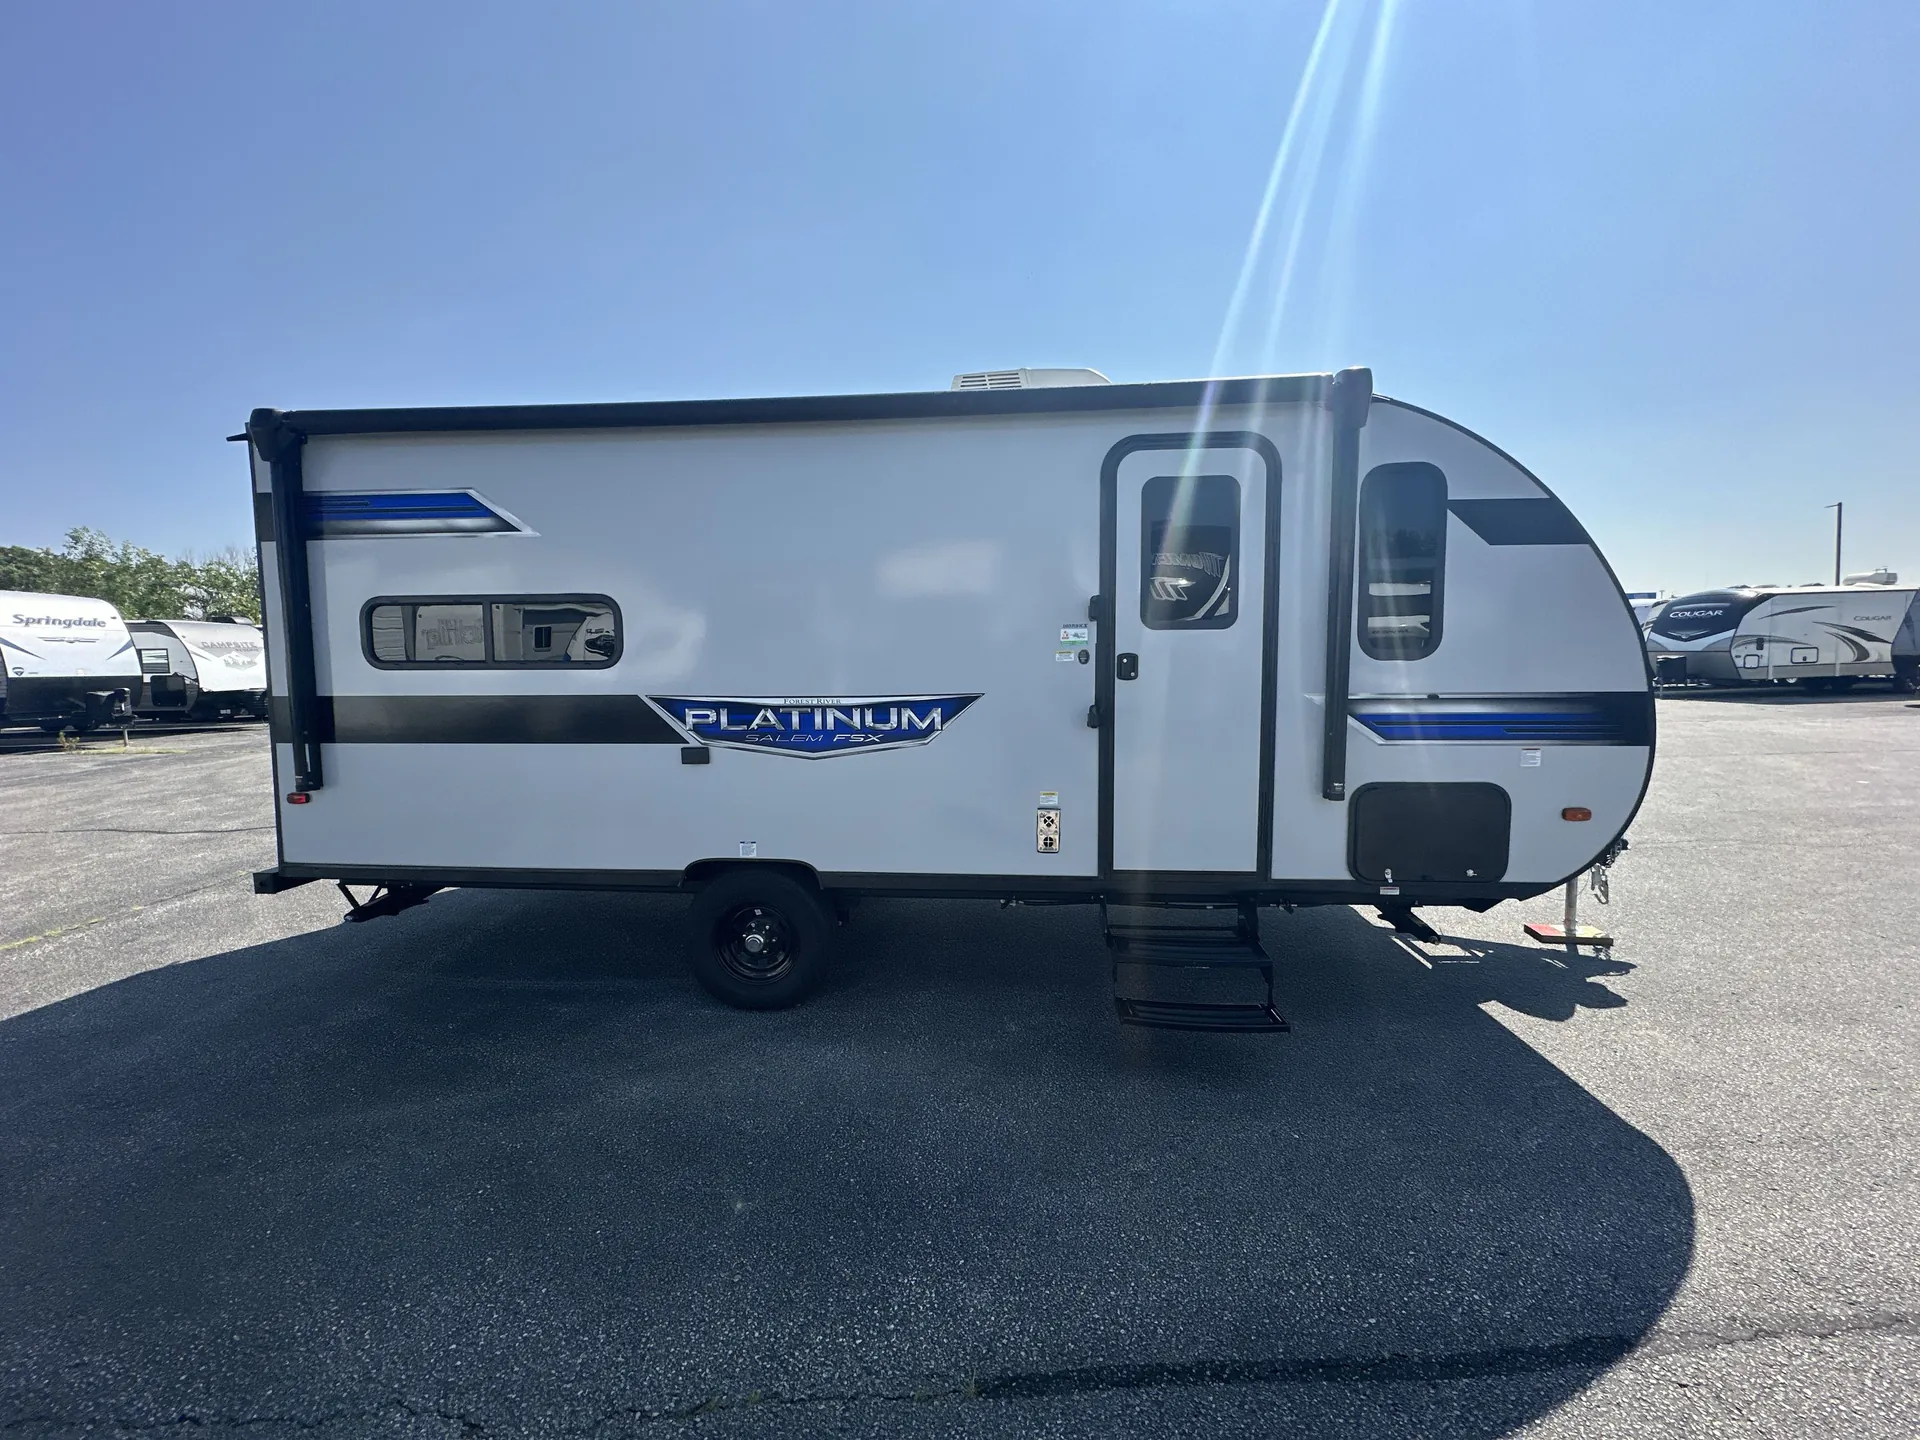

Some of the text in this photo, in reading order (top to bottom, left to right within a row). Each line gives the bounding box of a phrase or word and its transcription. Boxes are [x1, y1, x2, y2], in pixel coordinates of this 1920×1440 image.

[1669, 609, 1724, 618] COUGAR
[12, 614, 107, 629] Springdale
[684, 707, 943, 732] PLATINUM
[744, 733, 885, 743] SALEM FSX
